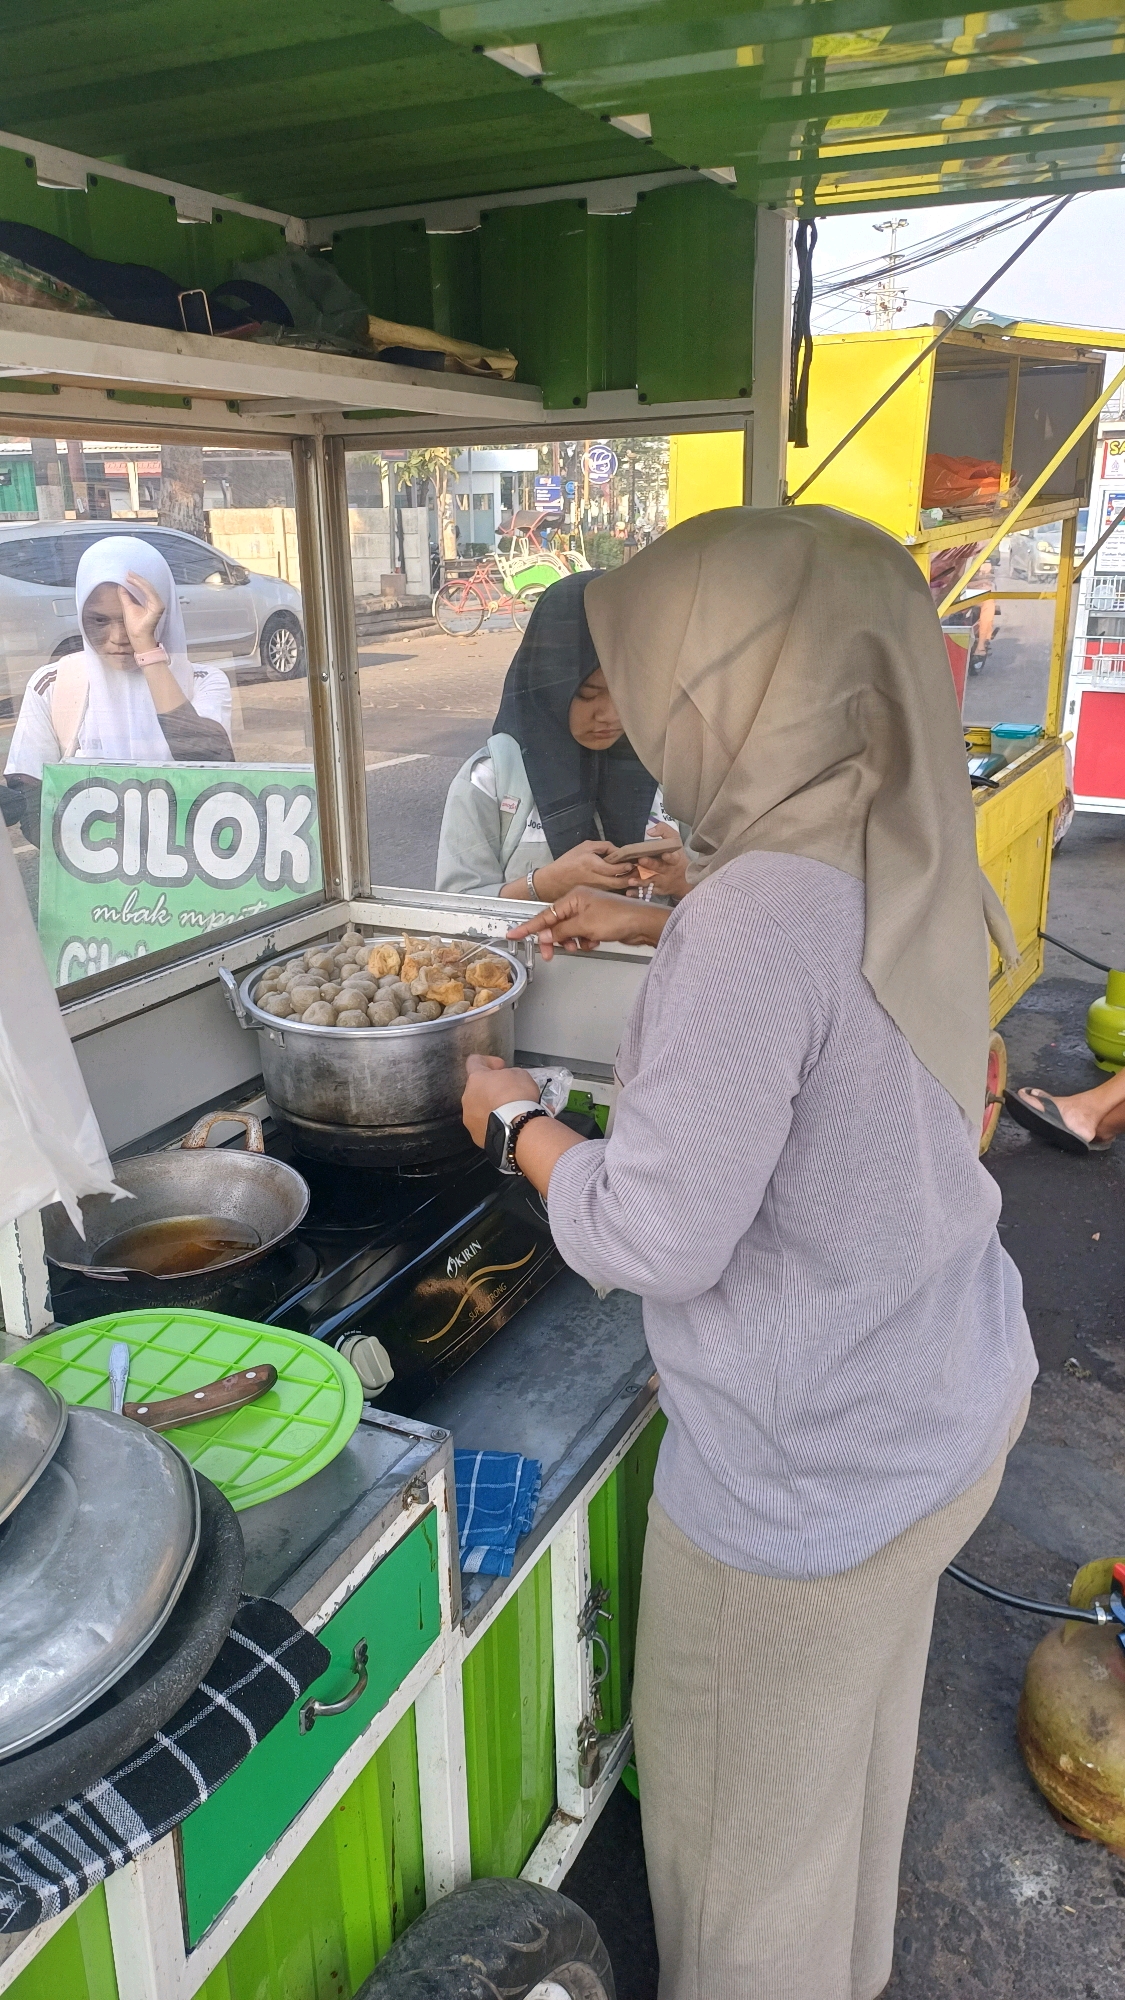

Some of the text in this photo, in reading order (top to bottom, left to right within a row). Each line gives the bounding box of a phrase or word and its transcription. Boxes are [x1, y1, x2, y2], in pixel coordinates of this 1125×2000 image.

[56, 782, 314, 888] CILOK
[92, 888, 171, 924] mbak
[455, 1240, 482, 1267] KIRIN
[486, 1283, 507, 1303] TRONG
